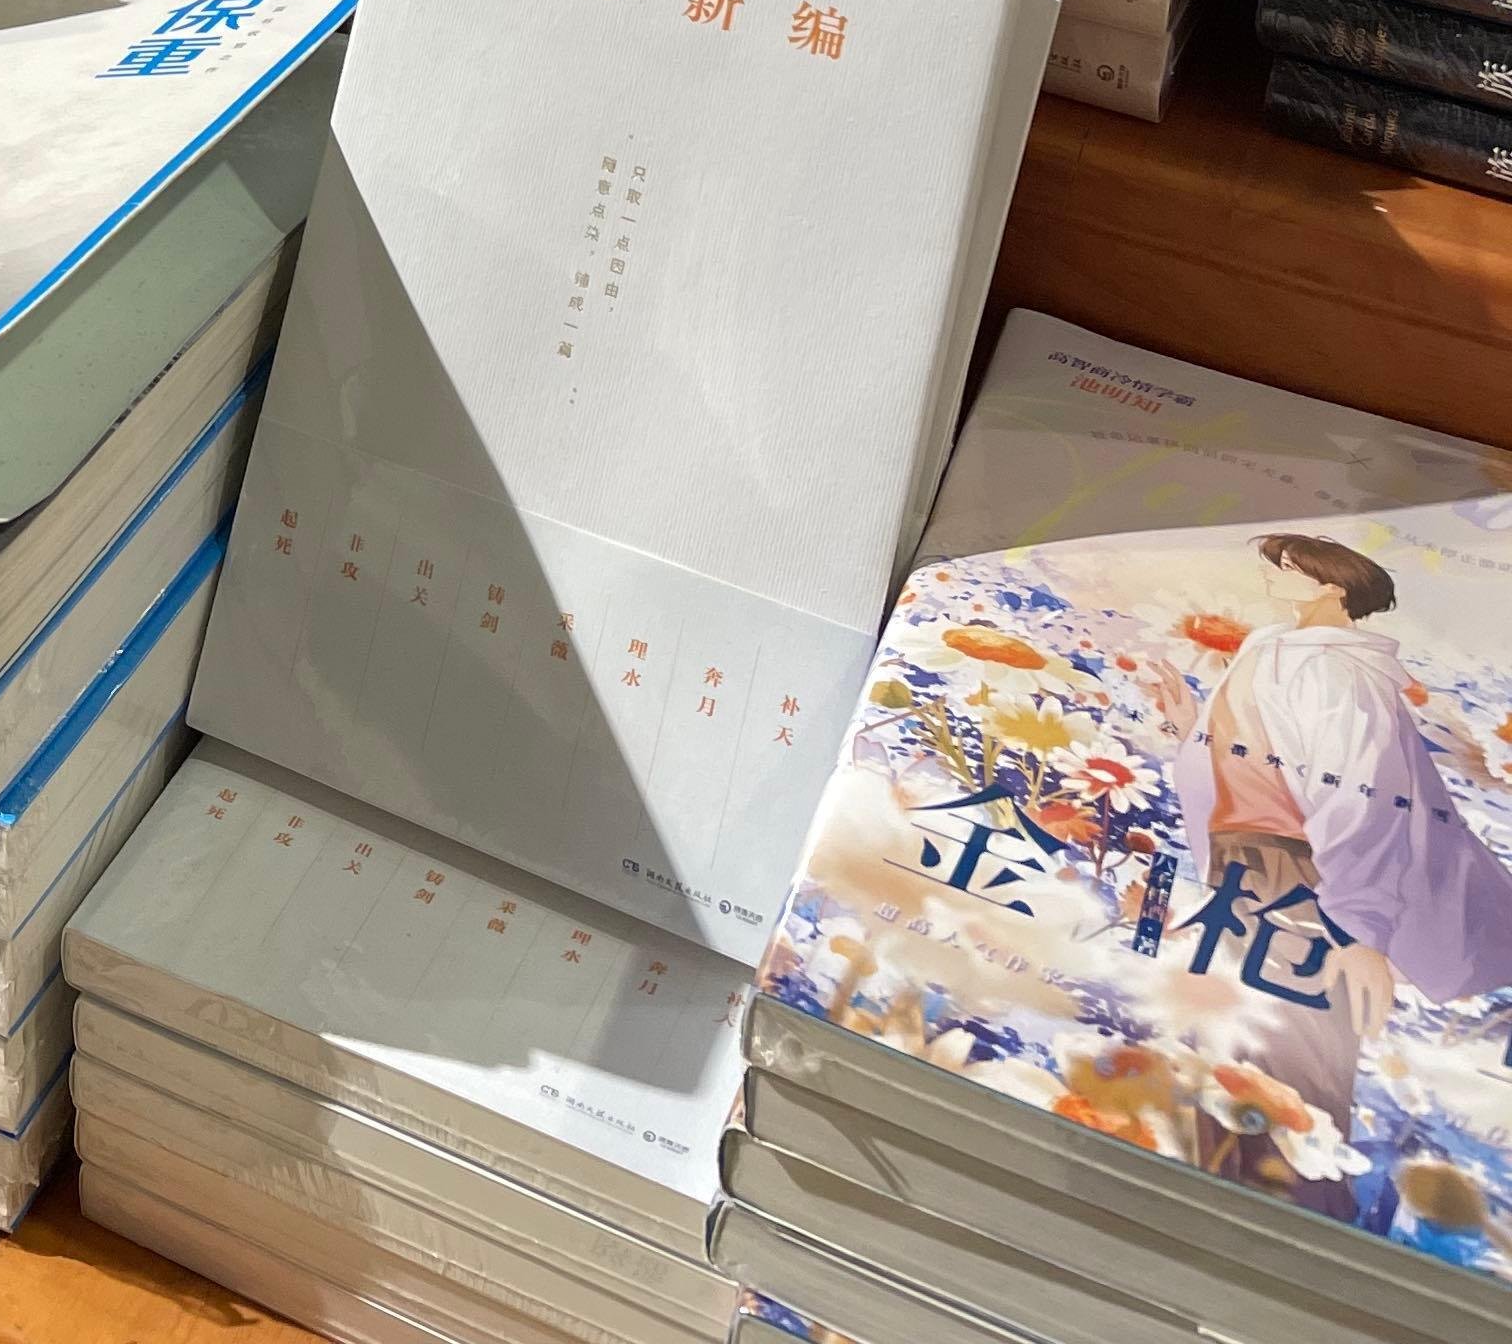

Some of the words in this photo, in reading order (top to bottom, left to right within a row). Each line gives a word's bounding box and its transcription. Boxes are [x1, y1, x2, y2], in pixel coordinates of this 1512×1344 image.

[339, 532, 366, 582] 非攻
[411, 558, 436, 606] 出关
[479, 581, 507, 634] 铸剑
[549, 609, 575, 662] 采薇
[620, 637, 650, 688] 理水
[695, 665, 725, 718] 奔月
[771, 693, 801, 748] 补天
